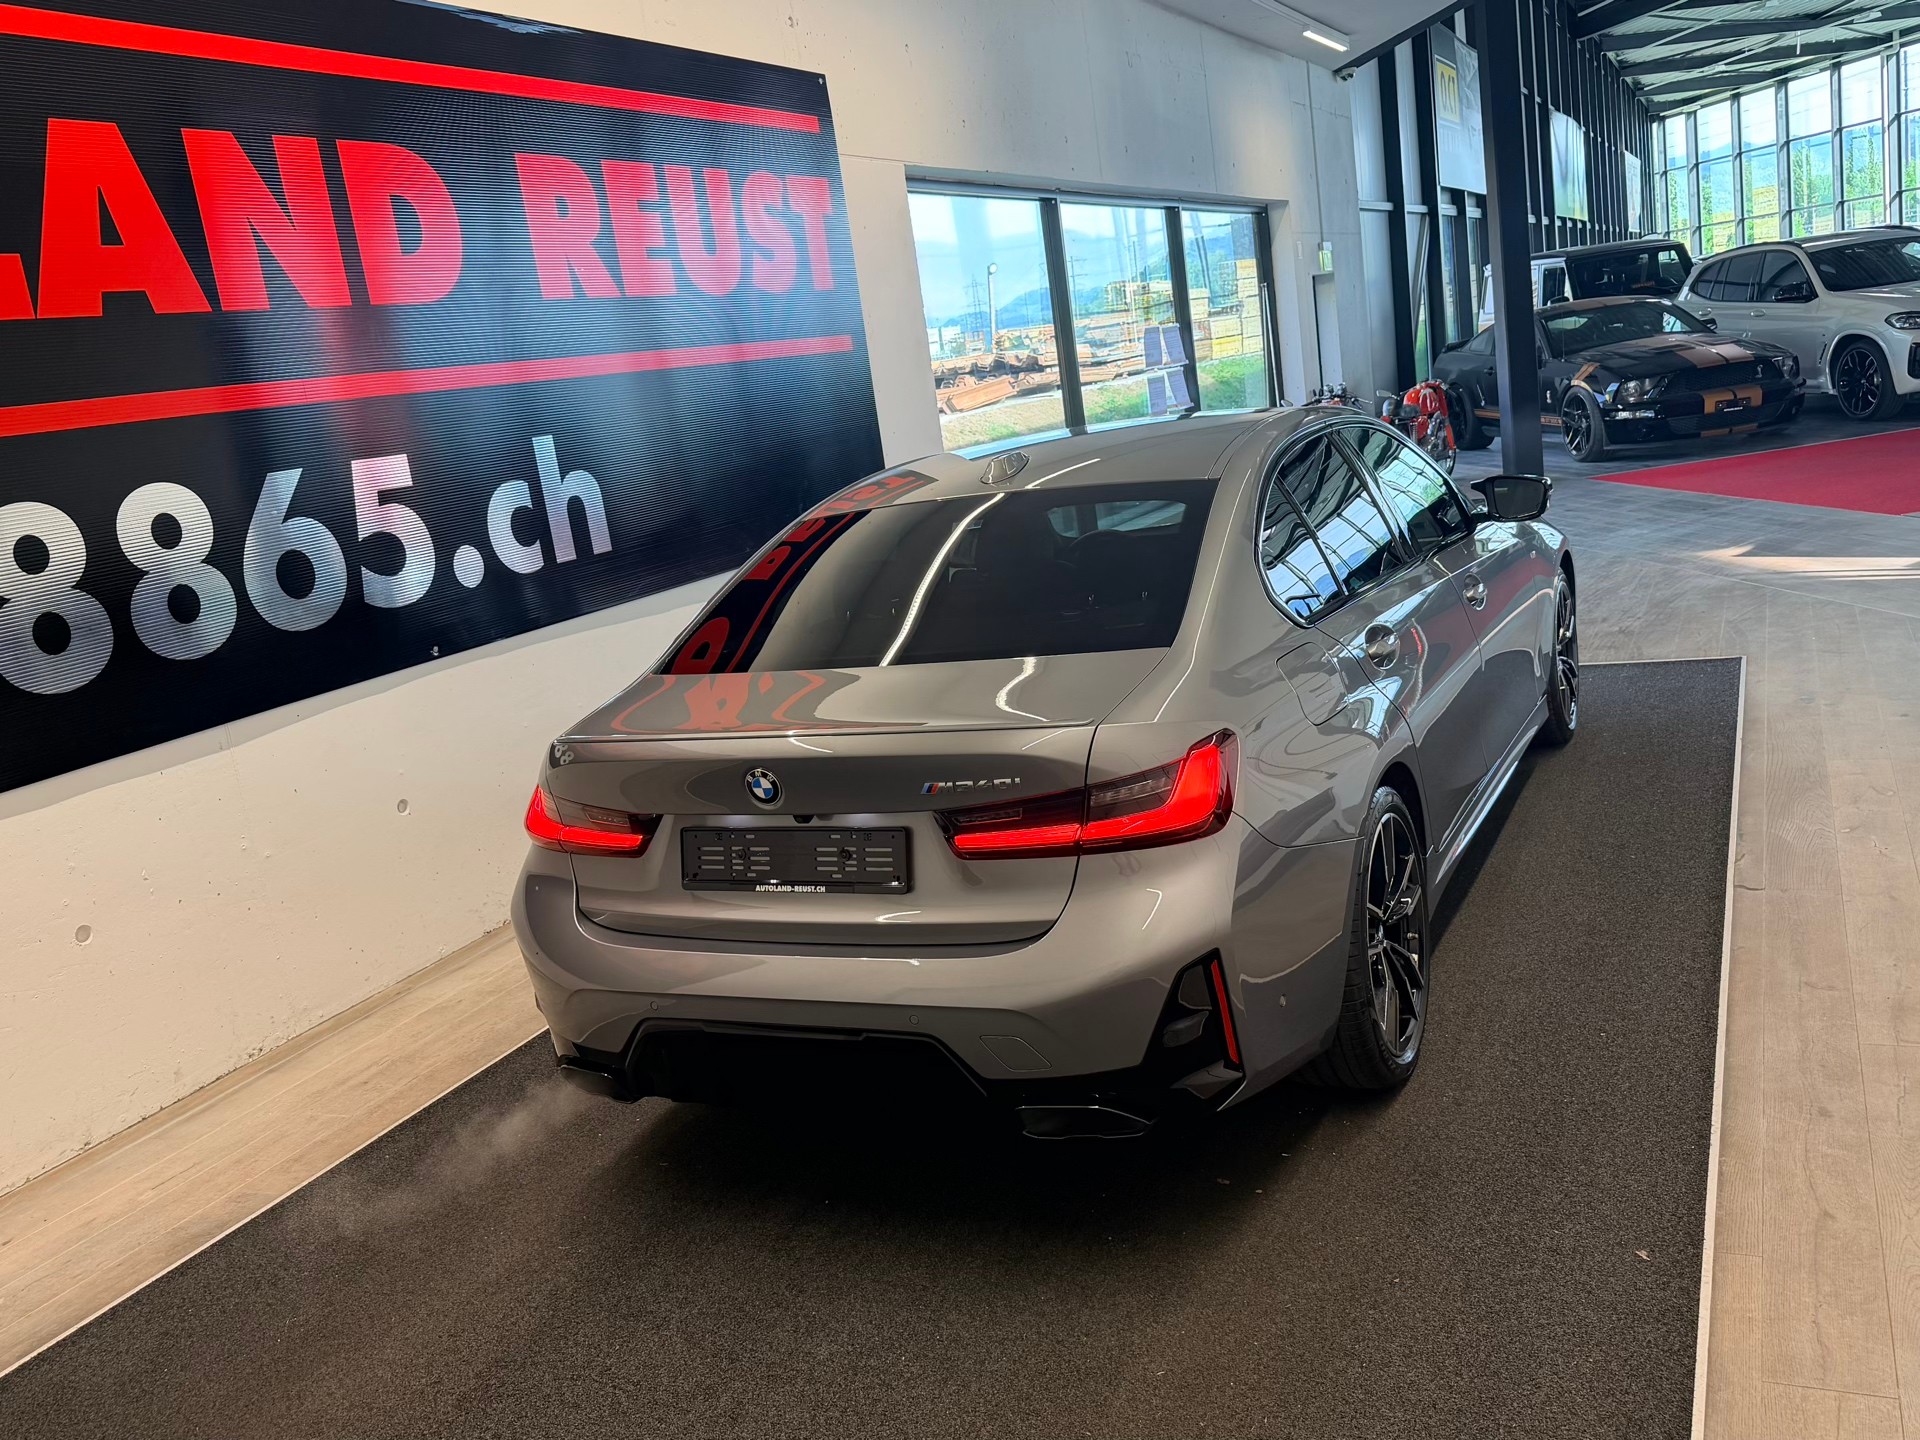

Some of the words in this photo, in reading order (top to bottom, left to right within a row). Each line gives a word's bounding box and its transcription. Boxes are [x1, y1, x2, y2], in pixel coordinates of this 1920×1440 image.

[0, 118, 463, 320] AND
[515, 152, 835, 299] REUST
[0, 435, 612, 695] 8865.ch
[746, 770, 775, 783] BMW
[755, 884, 826, 893] AUTOLAND-REUST.CH
